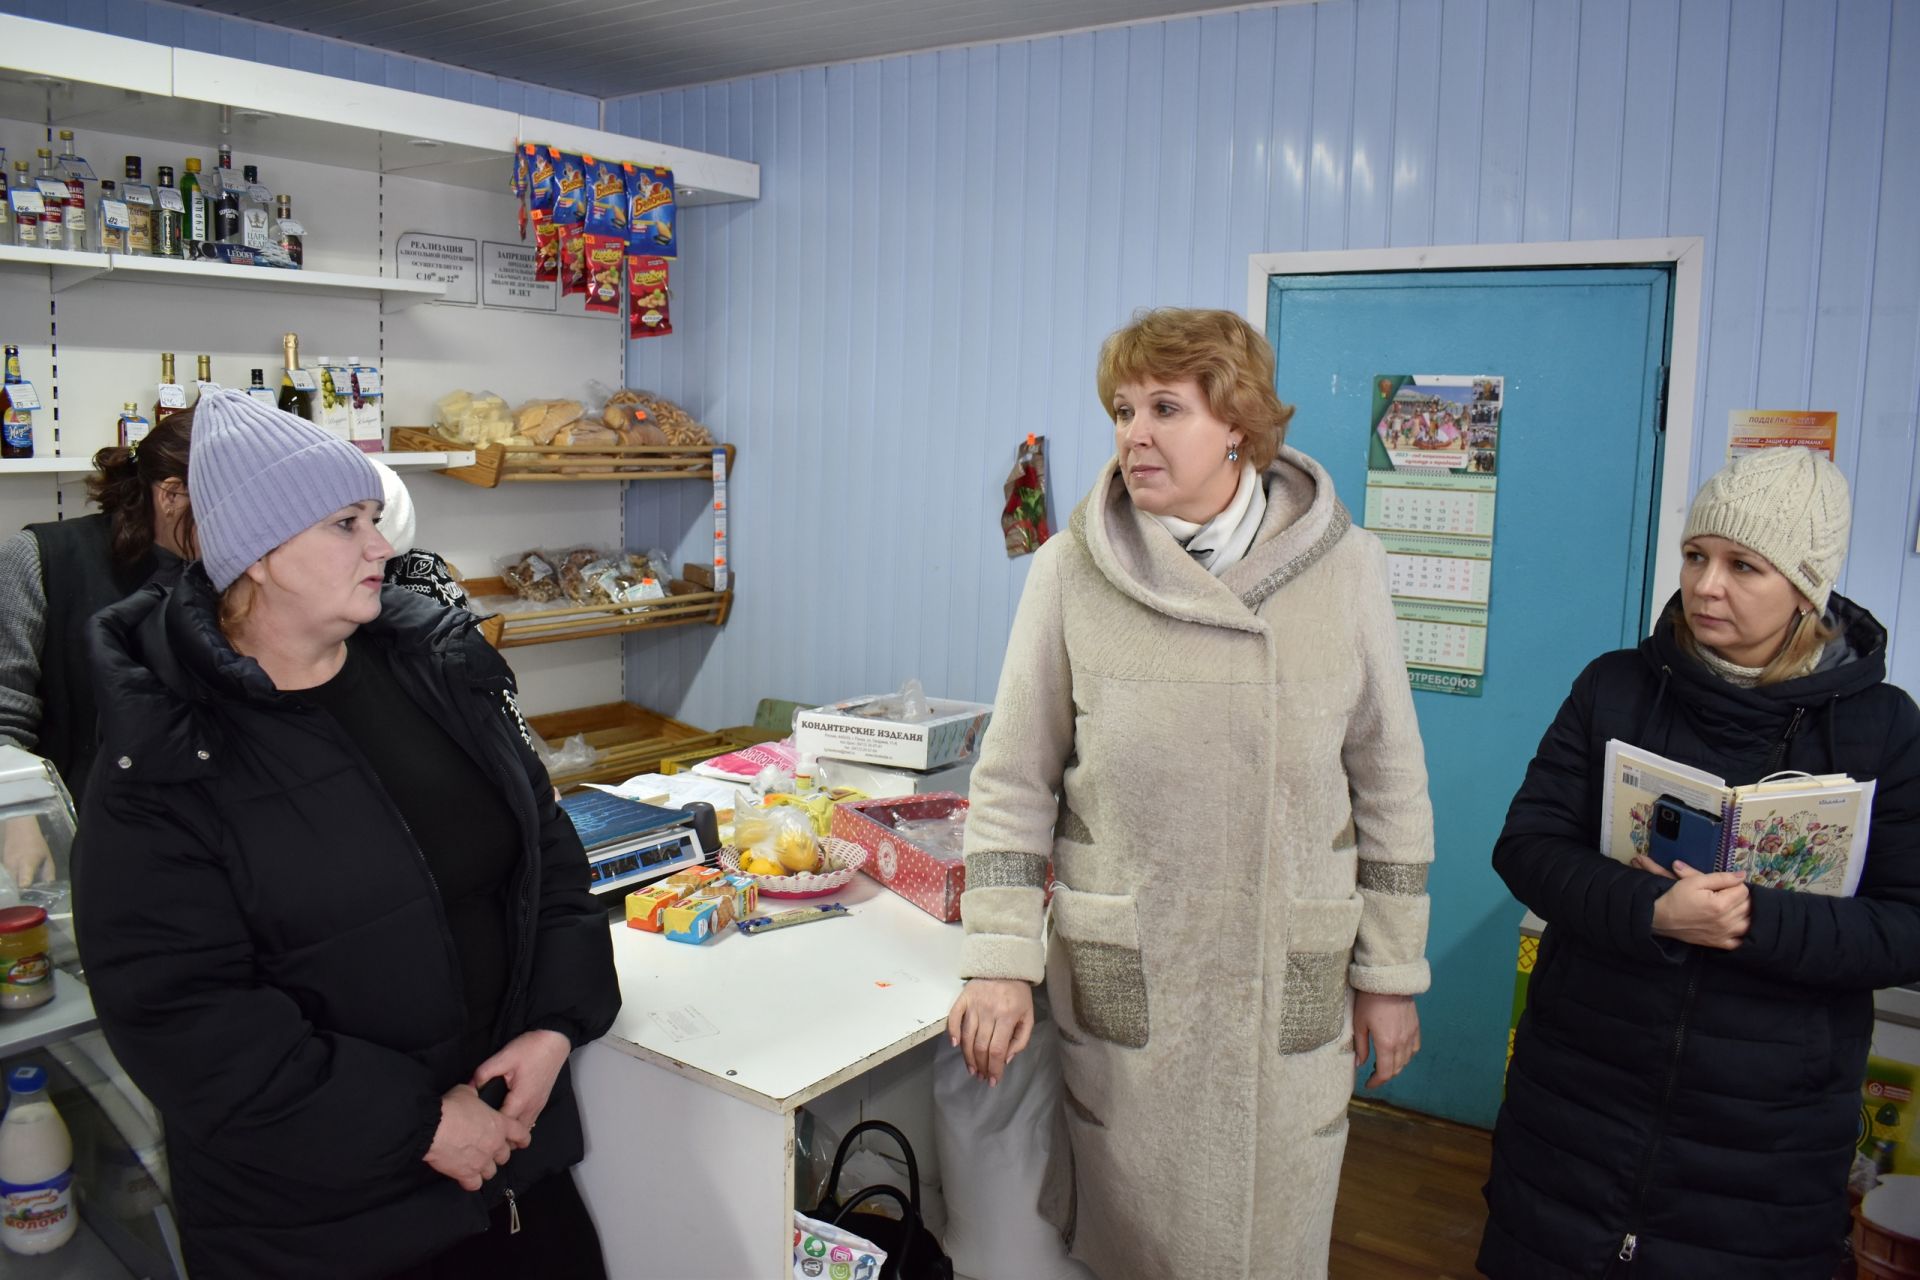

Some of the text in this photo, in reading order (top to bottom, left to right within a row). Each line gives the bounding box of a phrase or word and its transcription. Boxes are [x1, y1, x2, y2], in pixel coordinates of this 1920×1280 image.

[410, 240, 463, 254] РЕАЛИЗАЦИЯ
[498, 251, 536, 262] ЗАПРЕЩЕ
[1408, 671, 1477, 689] ОТРЕБСОЮЗ
[801, 720, 876, 737] КОНДИТЕРСКИЕ
[877, 729, 924, 743] ИЗДЕЛИЯ
[4, 1210, 68, 1229] МОЛОКО
